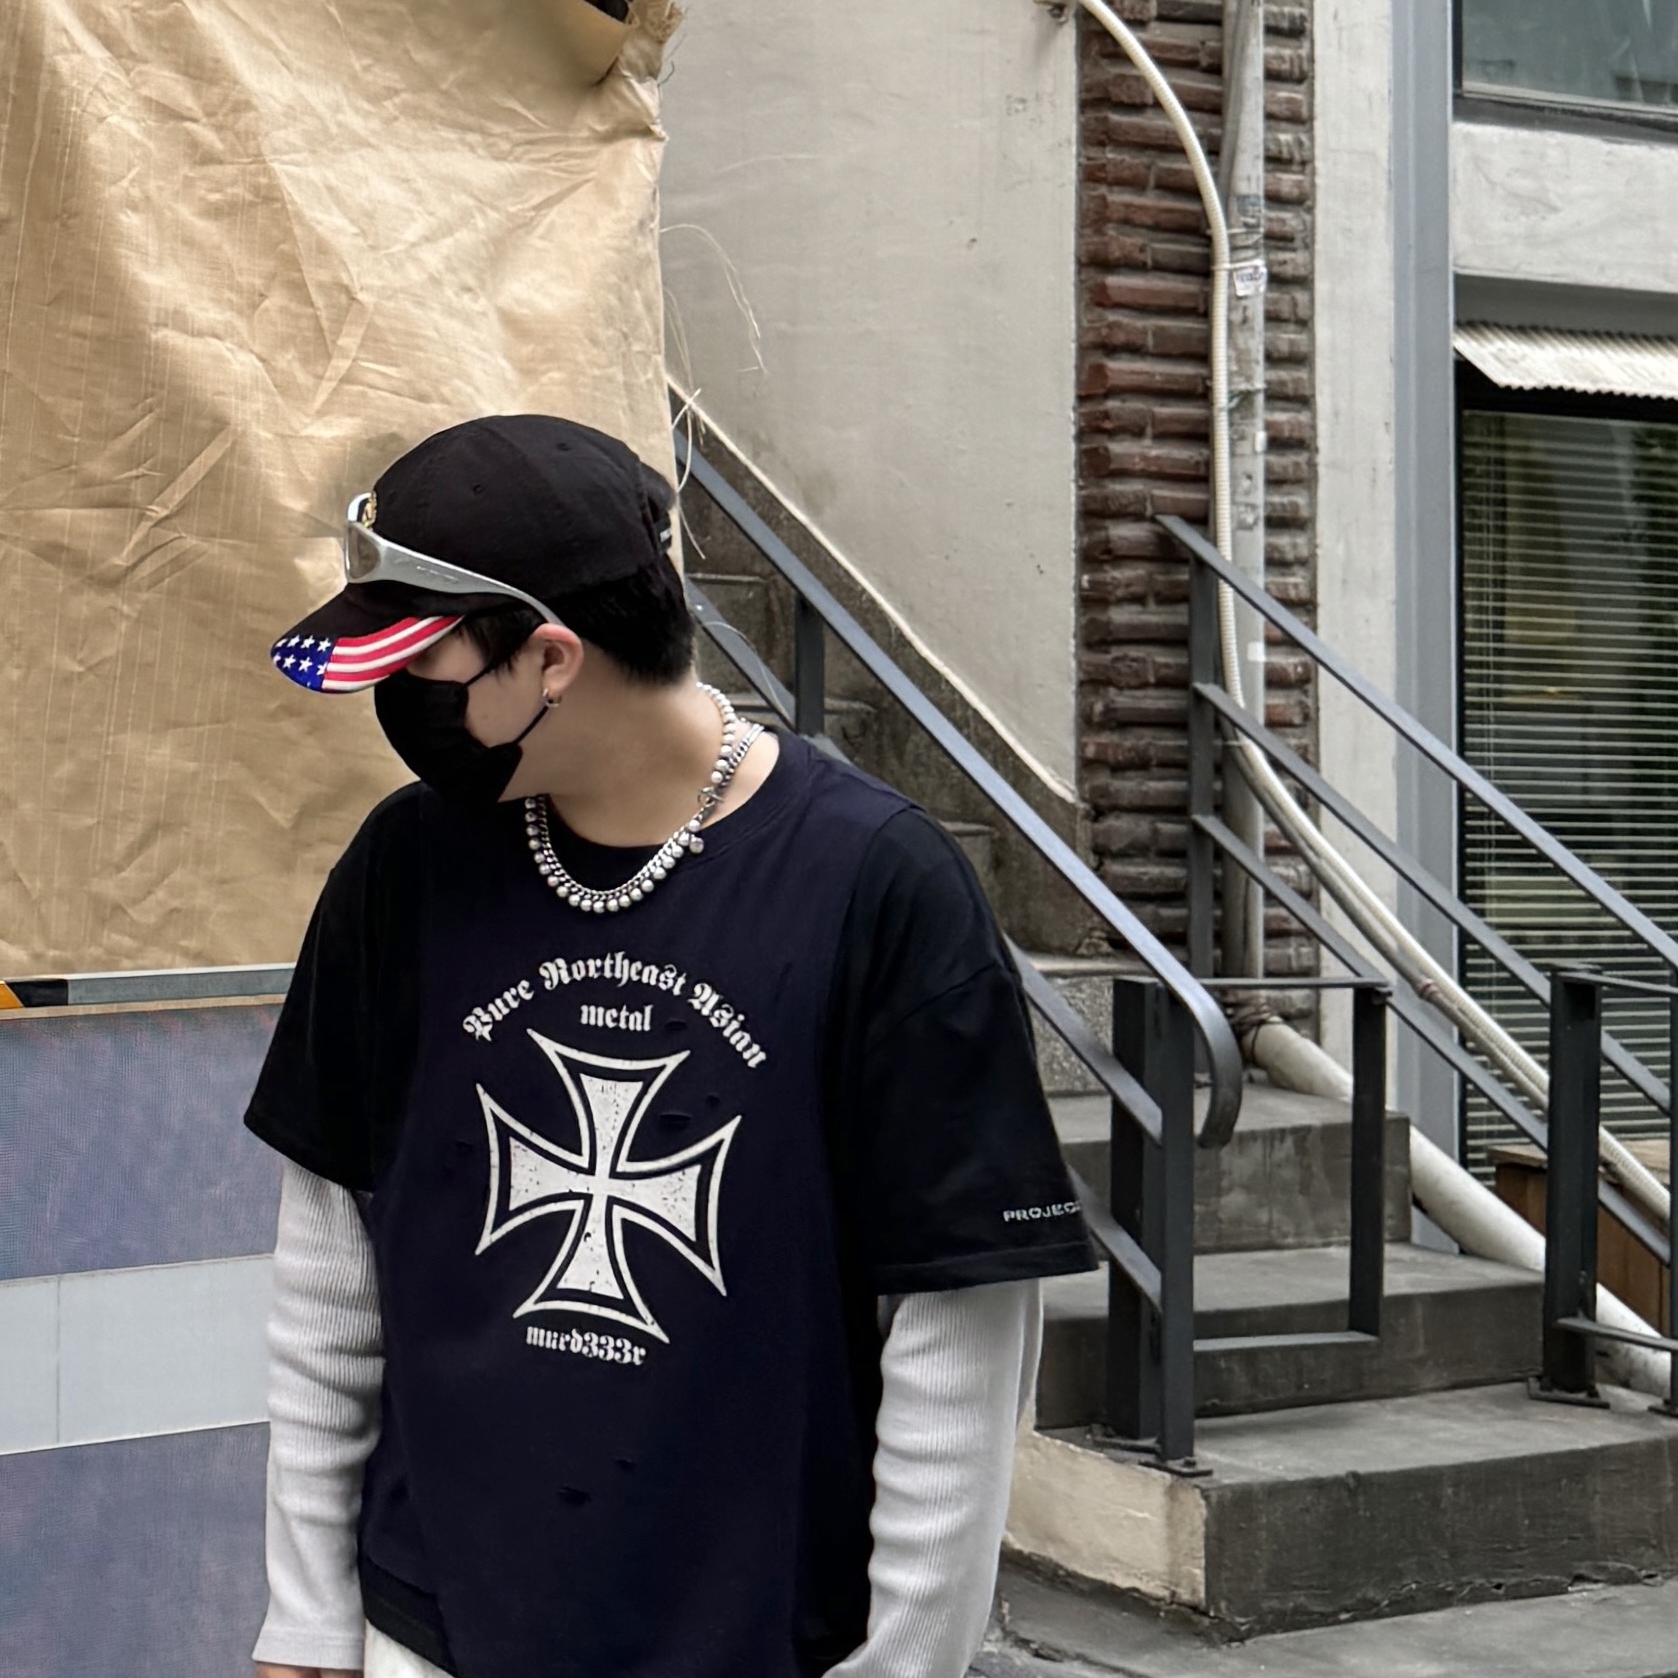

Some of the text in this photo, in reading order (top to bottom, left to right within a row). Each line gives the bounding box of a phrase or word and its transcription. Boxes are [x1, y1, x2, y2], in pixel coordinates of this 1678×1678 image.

[462, 951, 767, 1069] Pure Northeast Asian
[580, 1004, 654, 1032] metal
